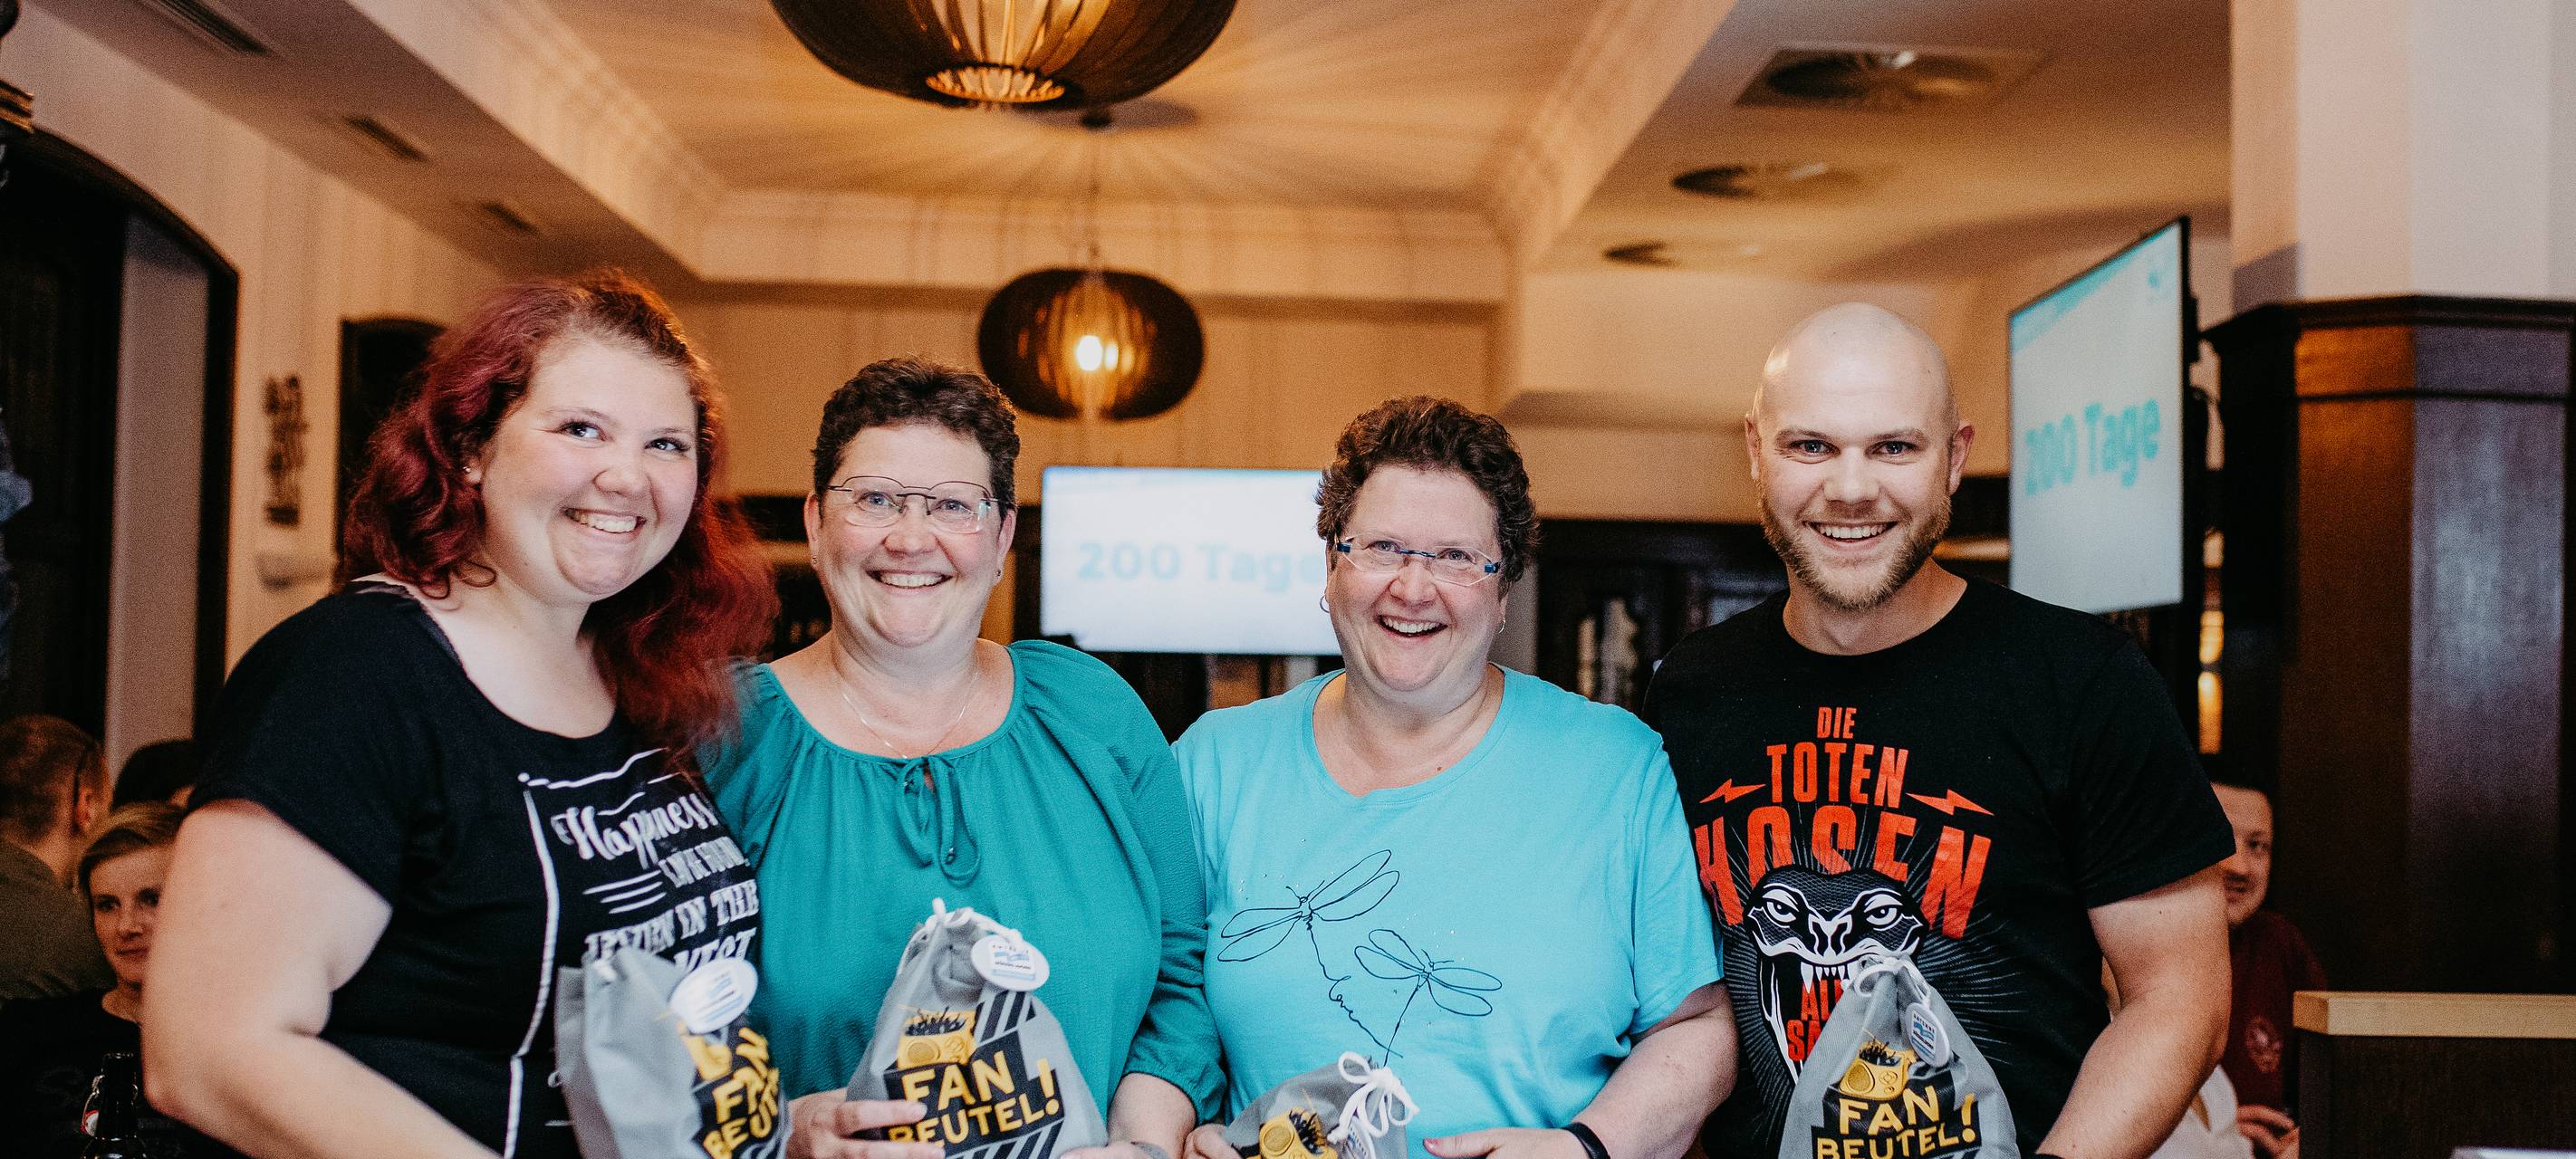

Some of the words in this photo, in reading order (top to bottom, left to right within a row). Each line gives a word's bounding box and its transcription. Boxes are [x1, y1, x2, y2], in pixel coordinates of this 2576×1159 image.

[2025, 414, 2078, 495] 200
[2085, 398, 2160, 488] Tage
[1076, 541, 1182, 580] 200
[1196, 541, 1324, 594] Tage
[1816, 706, 1857, 740] DIE
[1766, 742, 1909, 809] TOTEN
[1694, 804, 1992, 940] HOSEN
[888, 1058, 1060, 1145] BEUTEL!
[900, 1050, 1015, 1111] FAN
[1839, 1086, 1940, 1135] FAN
[1816, 1093, 1976, 1159] BEUTEL!
